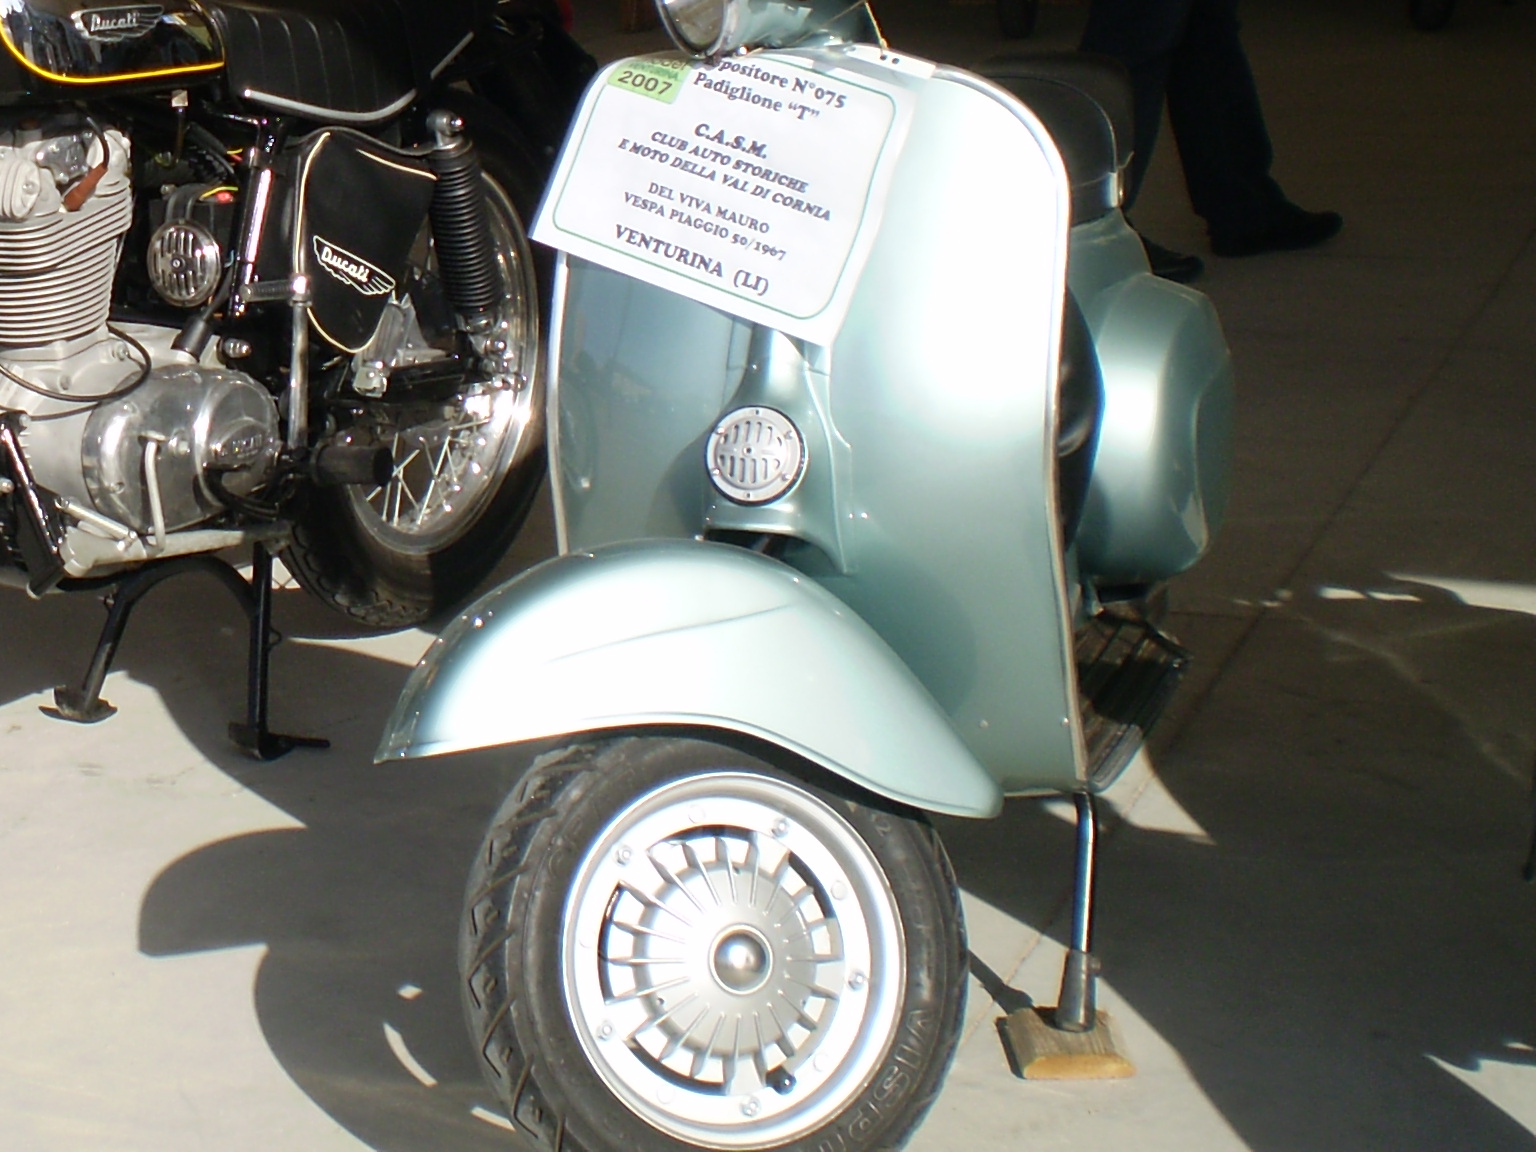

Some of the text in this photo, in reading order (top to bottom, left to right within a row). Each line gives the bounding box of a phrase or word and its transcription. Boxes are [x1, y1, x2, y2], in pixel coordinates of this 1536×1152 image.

[91, 10, 141, 32] Ducati
[617, 70, 673, 95] 2007
[693, 71, 783, 112] Padiglione
[792, 77, 848, 109] N°075
[694, 123, 768, 159] C.A.S.M.
[618, 138, 831, 222] E MOTO DELLA VAL DI CORNIA
[650, 130, 809, 194] CLUB AUTO STORICHE
[624, 191, 665, 217] VESPA
[670, 208, 729, 239] PIAGGIO
[648, 182, 770, 235] DEL VIVA MAURO
[322, 246, 369, 283] Ducati
[614, 224, 770, 297] VENTURINA (LI)
